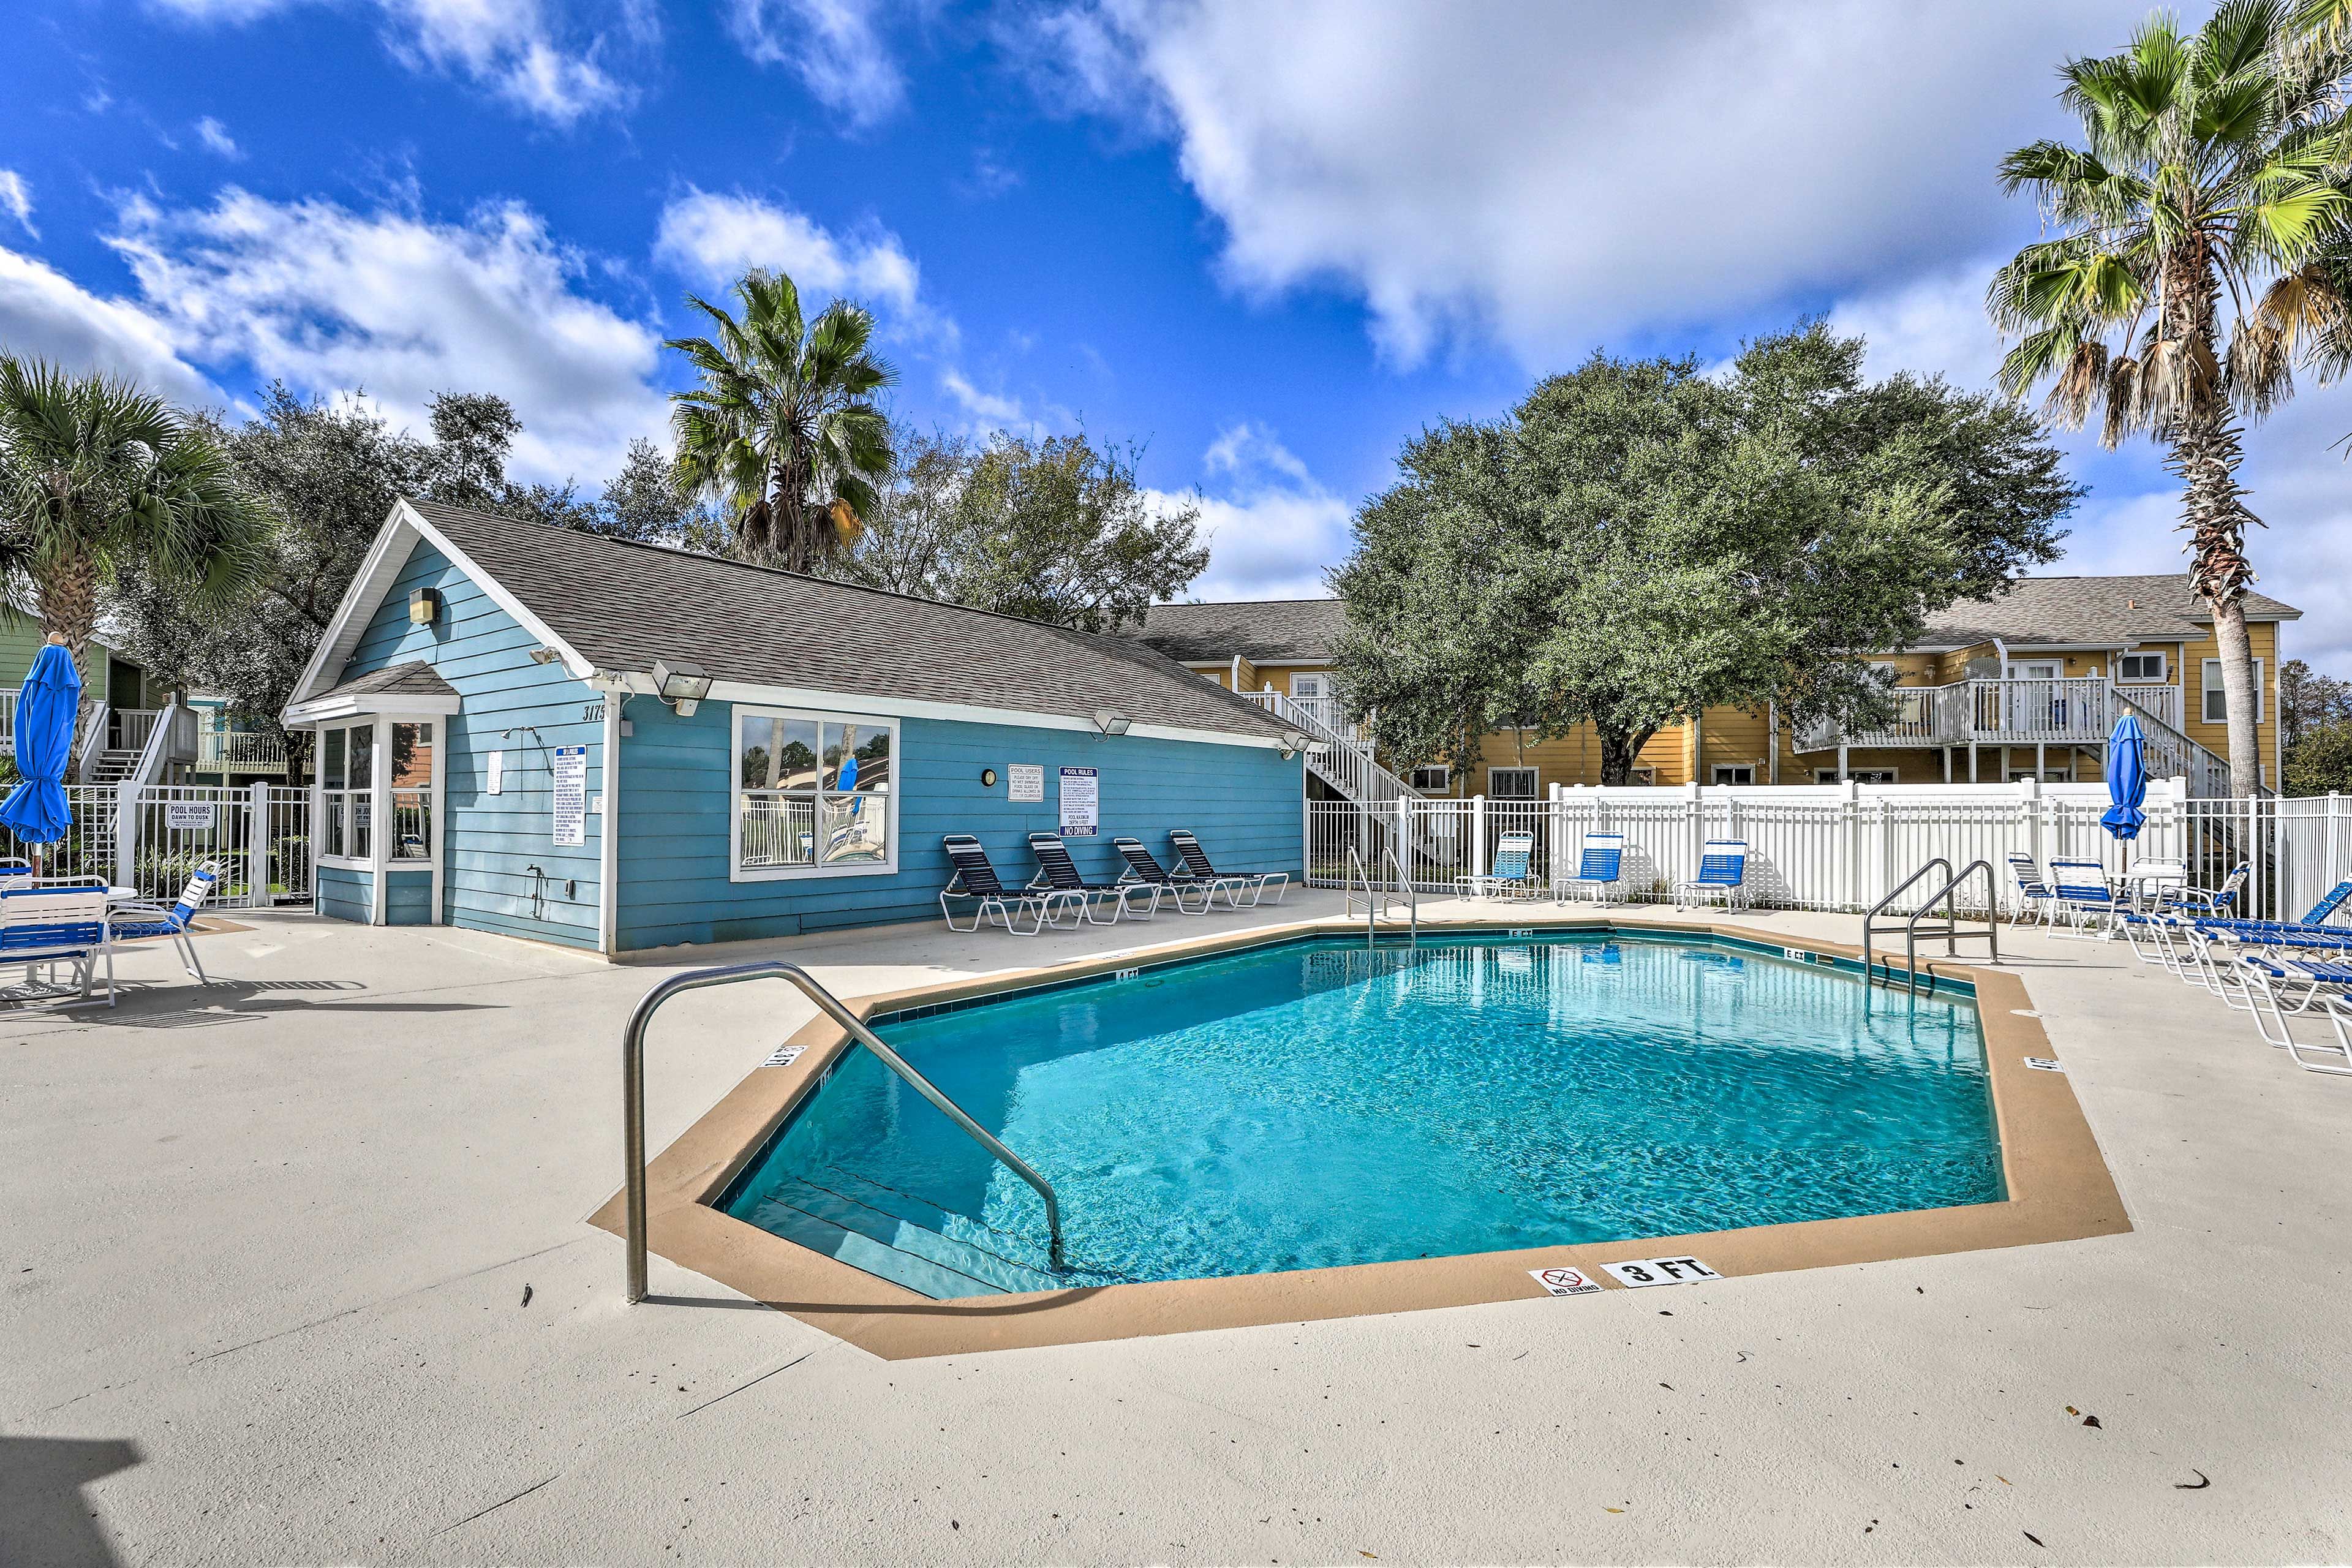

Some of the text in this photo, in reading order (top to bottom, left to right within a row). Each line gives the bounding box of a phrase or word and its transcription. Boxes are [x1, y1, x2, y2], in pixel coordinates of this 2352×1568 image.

[582, 704, 605, 721] 3175
[1065, 826, 1093, 835] NO DIVING
[1621, 1265, 1654, 1282] 3
